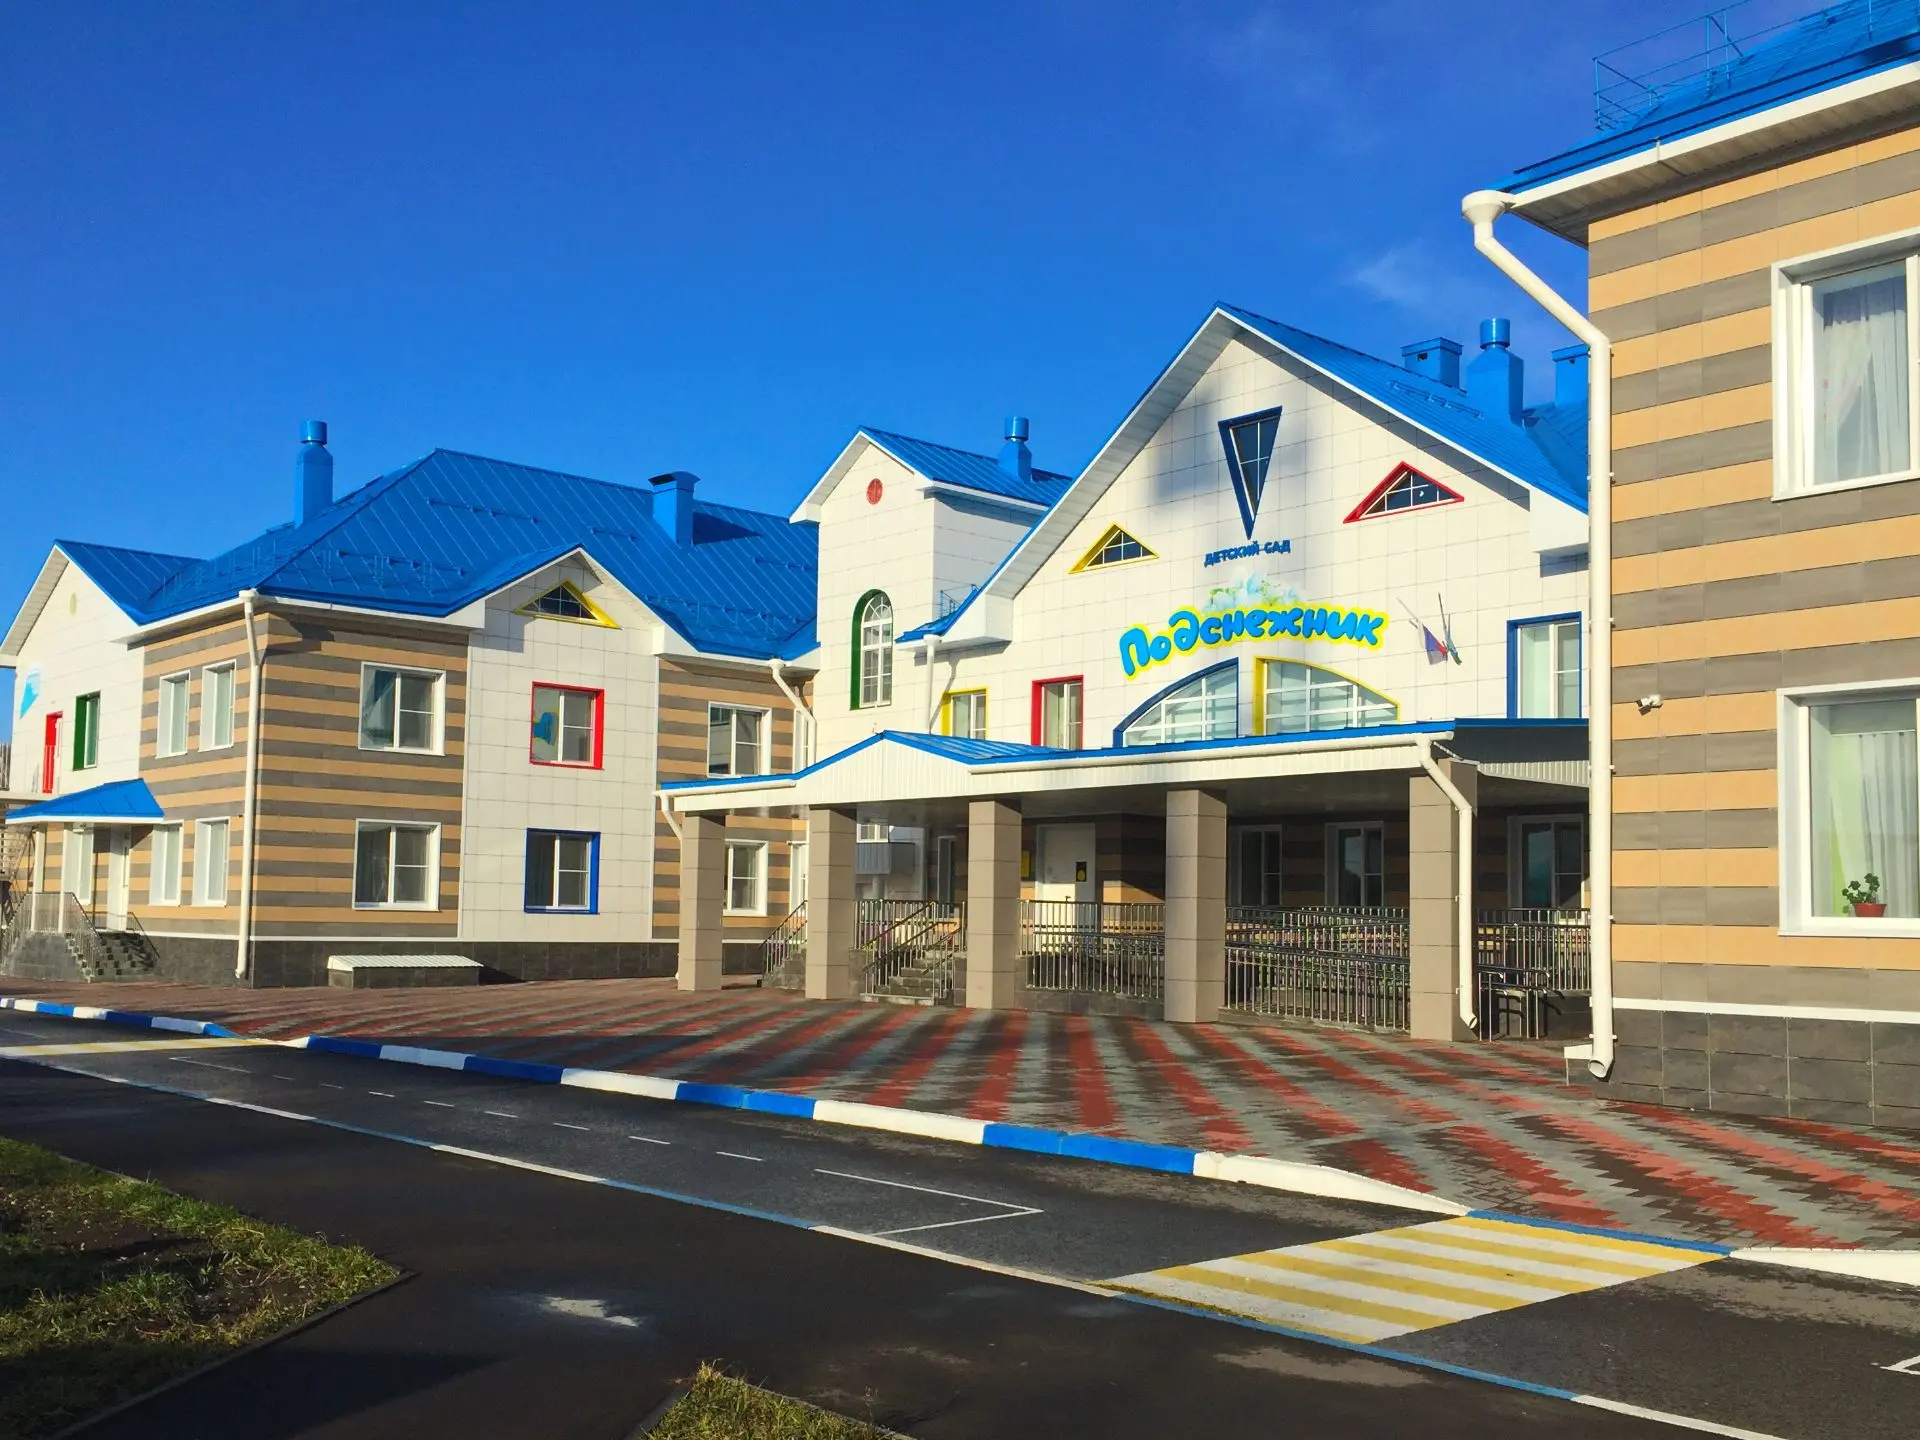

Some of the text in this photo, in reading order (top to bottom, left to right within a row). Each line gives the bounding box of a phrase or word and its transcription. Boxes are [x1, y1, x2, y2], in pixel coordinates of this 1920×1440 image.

[1203, 539, 1291, 568] ДЕТСКИЙ САД
[1118, 607, 1385, 677] Подснежник
